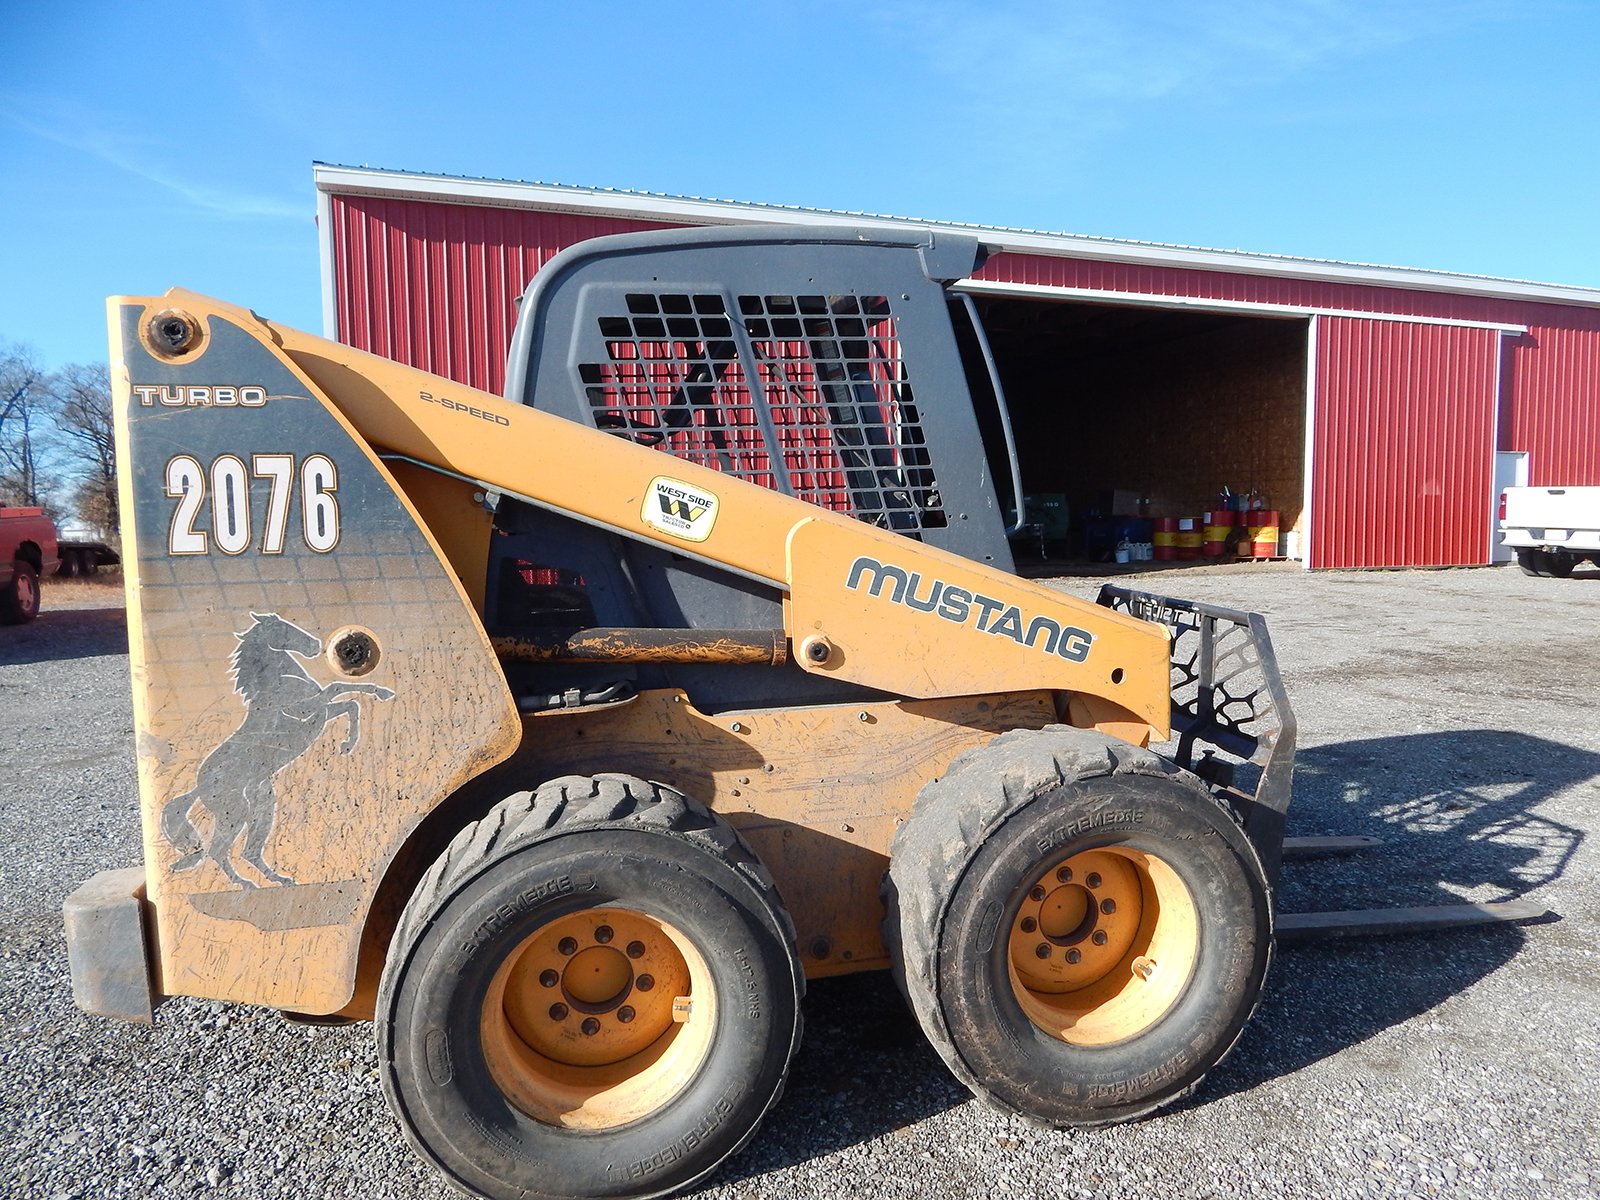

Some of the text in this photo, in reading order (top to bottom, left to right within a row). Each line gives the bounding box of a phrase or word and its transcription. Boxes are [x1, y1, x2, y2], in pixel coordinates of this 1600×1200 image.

[133, 385, 266, 407] TURBO
[419, 391, 510, 427] 2-SPEED
[165, 454, 341, 556] 2076
[657, 483, 713, 508] WEST SIDE
[845, 556, 1093, 664] MUSTANG
